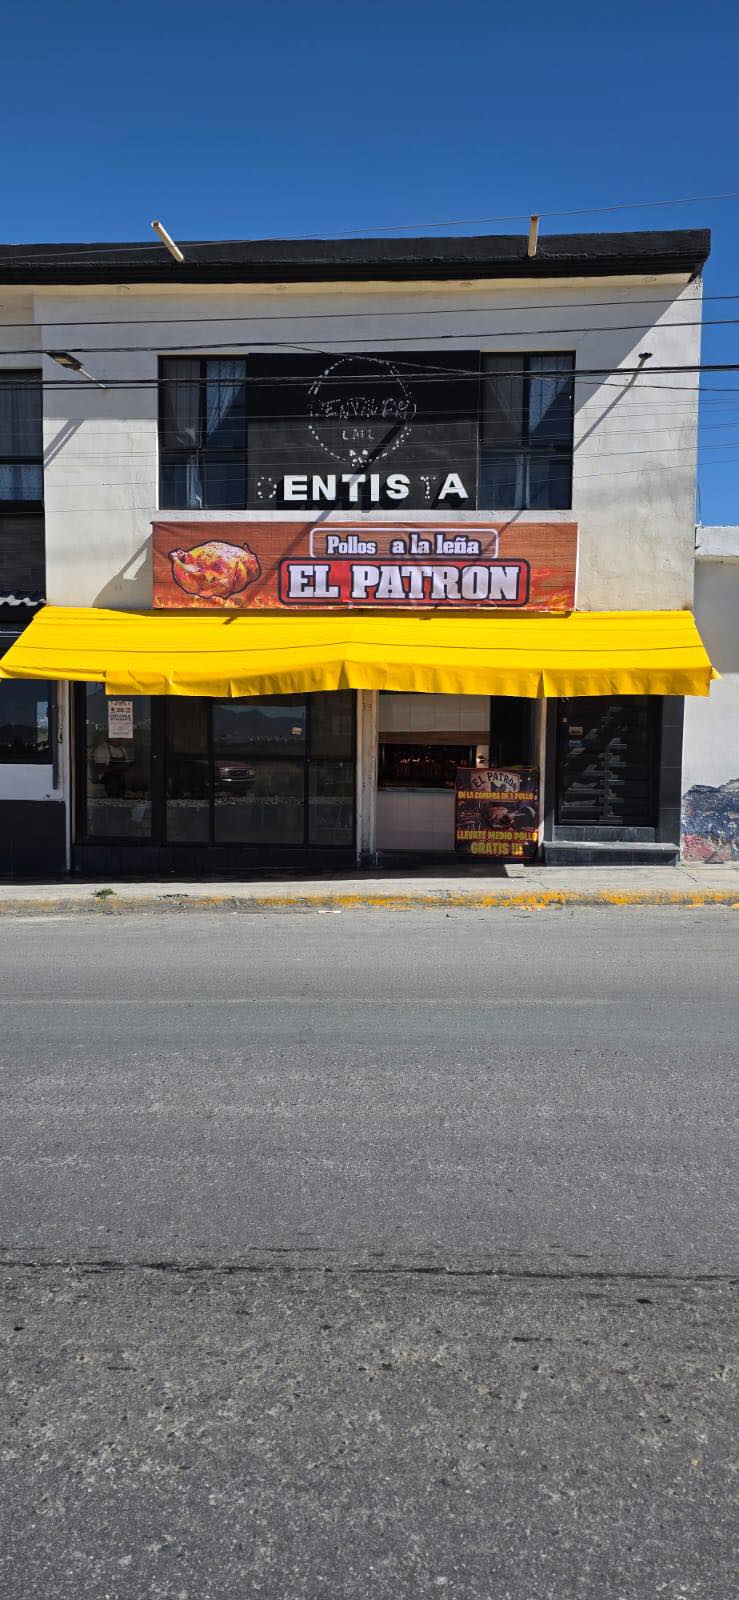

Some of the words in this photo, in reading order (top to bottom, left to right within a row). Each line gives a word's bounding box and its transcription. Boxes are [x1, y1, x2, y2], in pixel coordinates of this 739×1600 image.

[326, 535, 376, 555] Pollos
[391, 540, 405, 555] a
[411, 533, 430, 555] la
[436, 534, 480, 555] leña
[287, 564, 340, 599] EL
[351, 564, 520, 601] PATRON
[472, 776, 486, 789] EL
[487, 771, 518, 790] PATRON
[467, 791, 474, 800] LA
[475, 791, 500, 800] COMPRA
[502, 792, 510, 800] DE
[515, 792, 534, 800] POLLO
[488, 831, 513, 841] MEDIO
[514, 831, 538, 842] POLLO
[471, 842, 509, 854] GRATIS
